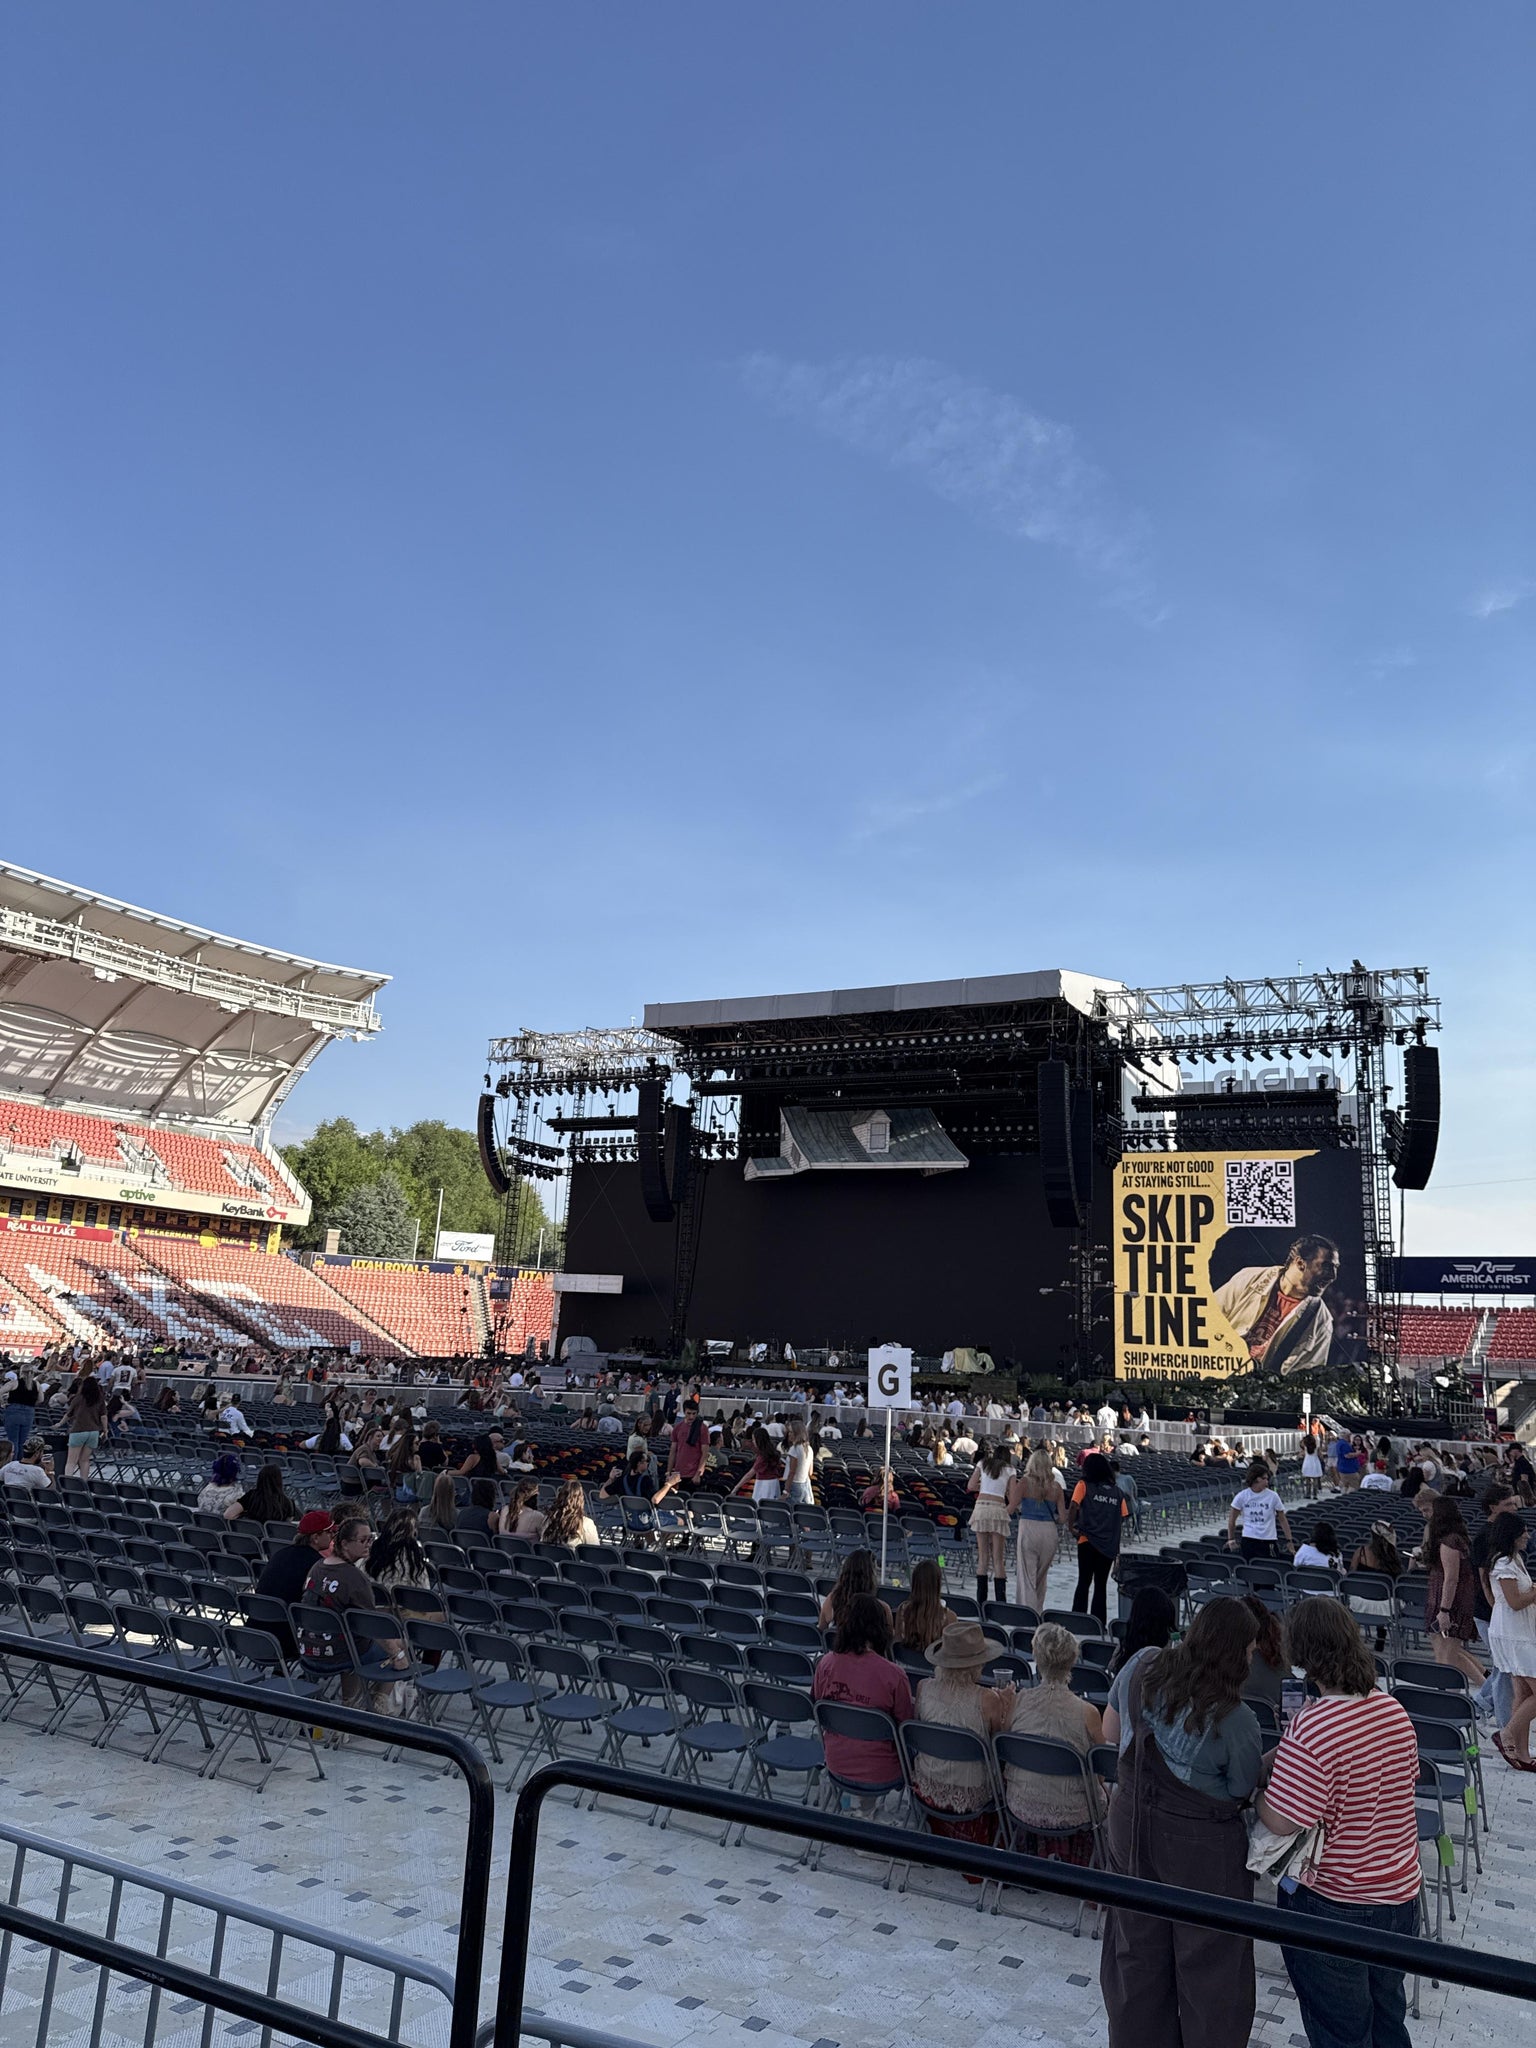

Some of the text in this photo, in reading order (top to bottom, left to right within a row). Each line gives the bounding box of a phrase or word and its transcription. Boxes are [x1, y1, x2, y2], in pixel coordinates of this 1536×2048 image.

[1122, 1160, 1214, 1174] IF YOU'RE NOT GOOD
[15, 1173, 58, 1187] UNIVERSITY
[1122, 1175, 1211, 1188] AT STAYING STILL...
[119, 1188, 156, 1202] aptive
[221, 1202, 266, 1218] KeyBank
[1122, 1193, 1215, 1243] SKIP
[6, 1220, 77, 1237] REAL SALT LAKE
[451, 1239, 480, 1254] Ford
[351, 1259, 430, 1274] UTAH ROYALS
[1122, 1244, 1197, 1295] THE
[1440, 1274, 1531, 1284] AMERICA FIRST
[1123, 1294, 1209, 1348] LINE
[1124, 1351, 1243, 1372] SHIP MERCH DIRECTLY
[877, 1363, 899, 1397] G
[1124, 1367, 1137, 1381] TO
[1139, 1367, 1168, 1381] YOUR
[1093, 1494, 1108, 1503] ASK
